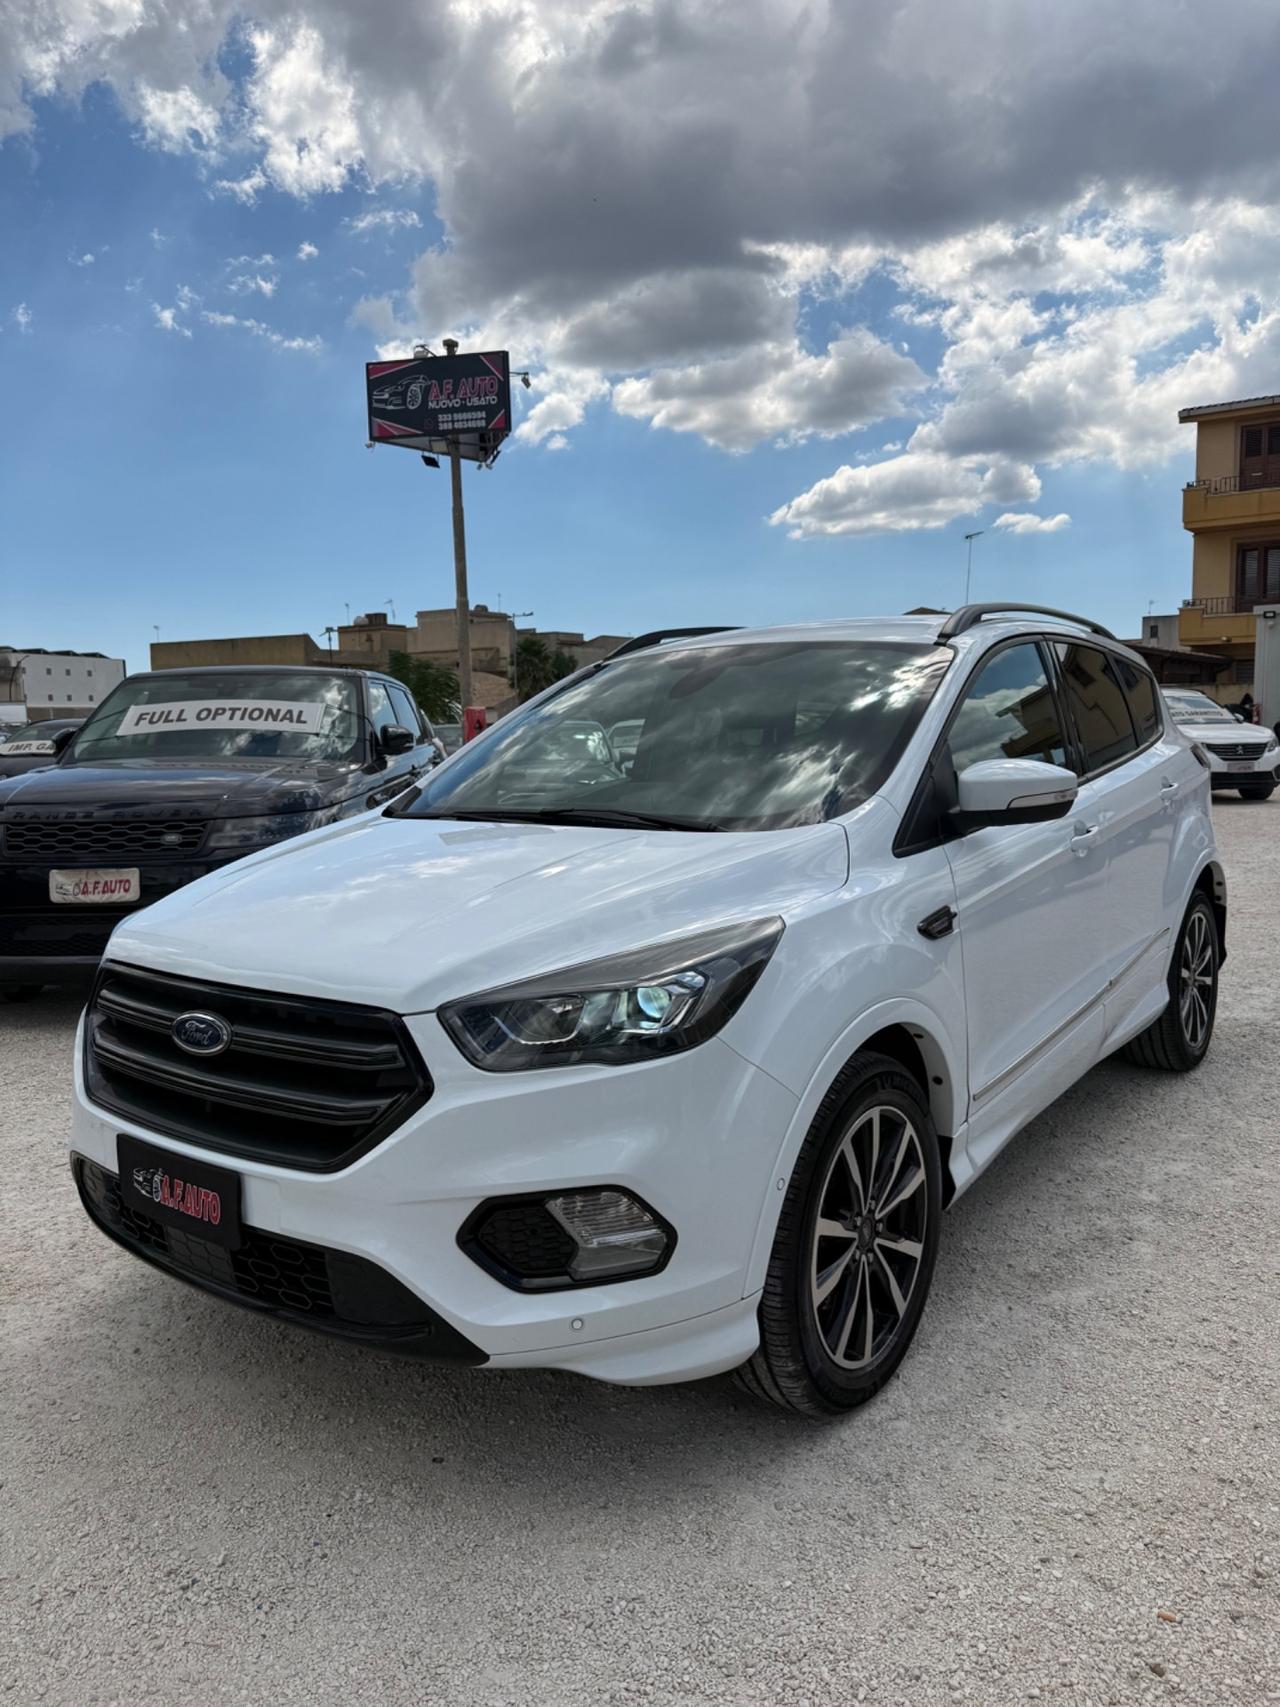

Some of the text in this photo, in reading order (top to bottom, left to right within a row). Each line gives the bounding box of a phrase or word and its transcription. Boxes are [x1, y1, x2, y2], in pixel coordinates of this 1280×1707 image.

[456, 376, 498, 398] AUTO
[428, 399, 461, 409] NUOVO
[466, 396, 498, 406] USATO
[134, 707, 308, 727] FULL OPTIONAL
[180, 1020, 213, 1046] Ford
